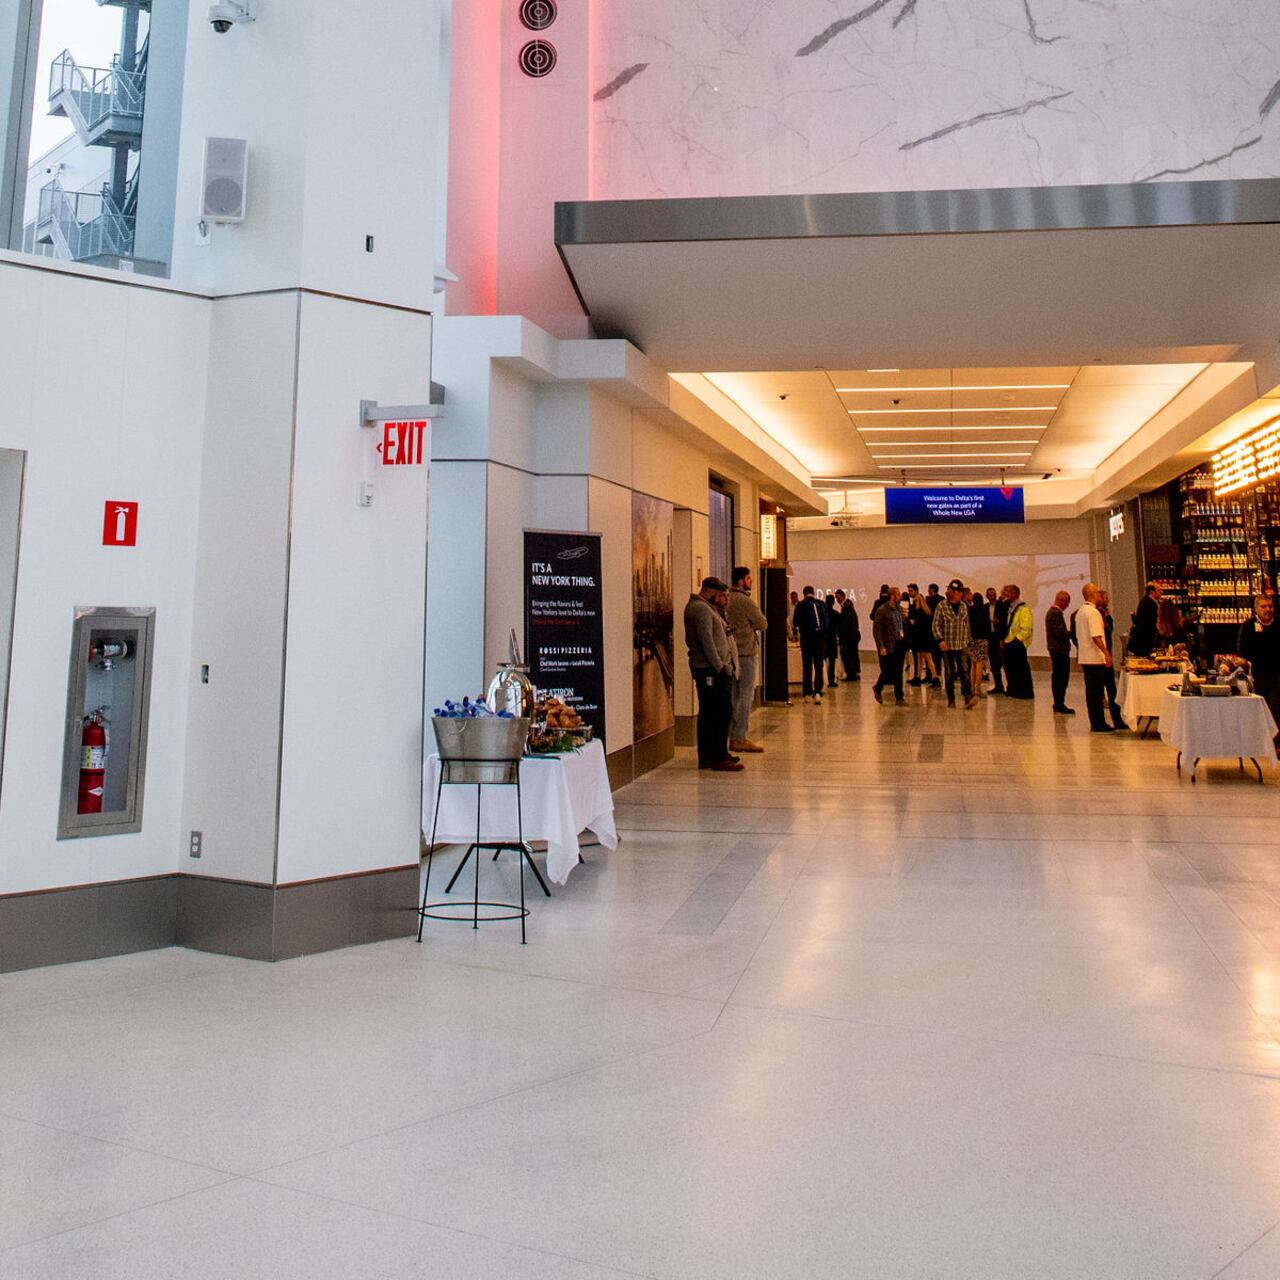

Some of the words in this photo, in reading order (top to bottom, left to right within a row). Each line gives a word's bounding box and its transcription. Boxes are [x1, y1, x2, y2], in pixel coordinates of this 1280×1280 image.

[383, 421, 427, 465] EXIT
[532, 562, 545, 574] IT'S
[546, 563, 553, 574] A
[532, 575, 550, 586] NEW
[550, 575, 570, 587] YORK
[571, 576, 596, 587] THING.
[539, 647, 560, 655] ROSSI
[561, 647, 593, 655] PIZZERIA
